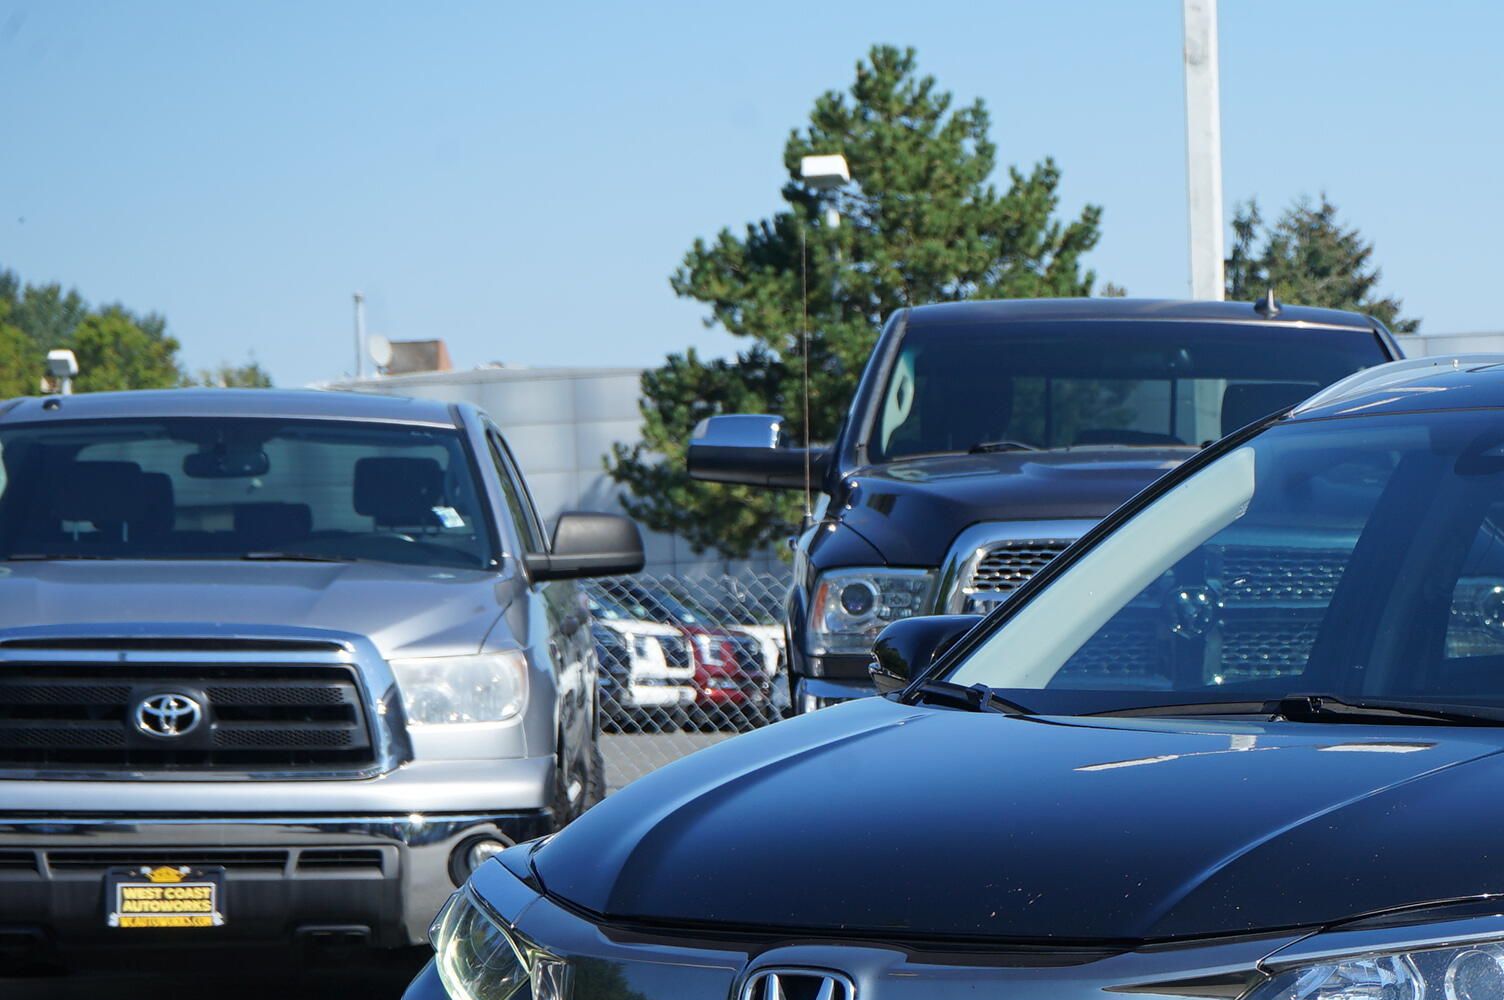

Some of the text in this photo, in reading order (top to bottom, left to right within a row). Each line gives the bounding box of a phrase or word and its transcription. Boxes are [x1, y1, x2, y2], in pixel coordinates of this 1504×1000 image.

[123, 887, 211, 899] WEST COAST
[123, 900, 211, 912] AUTOWORKS
